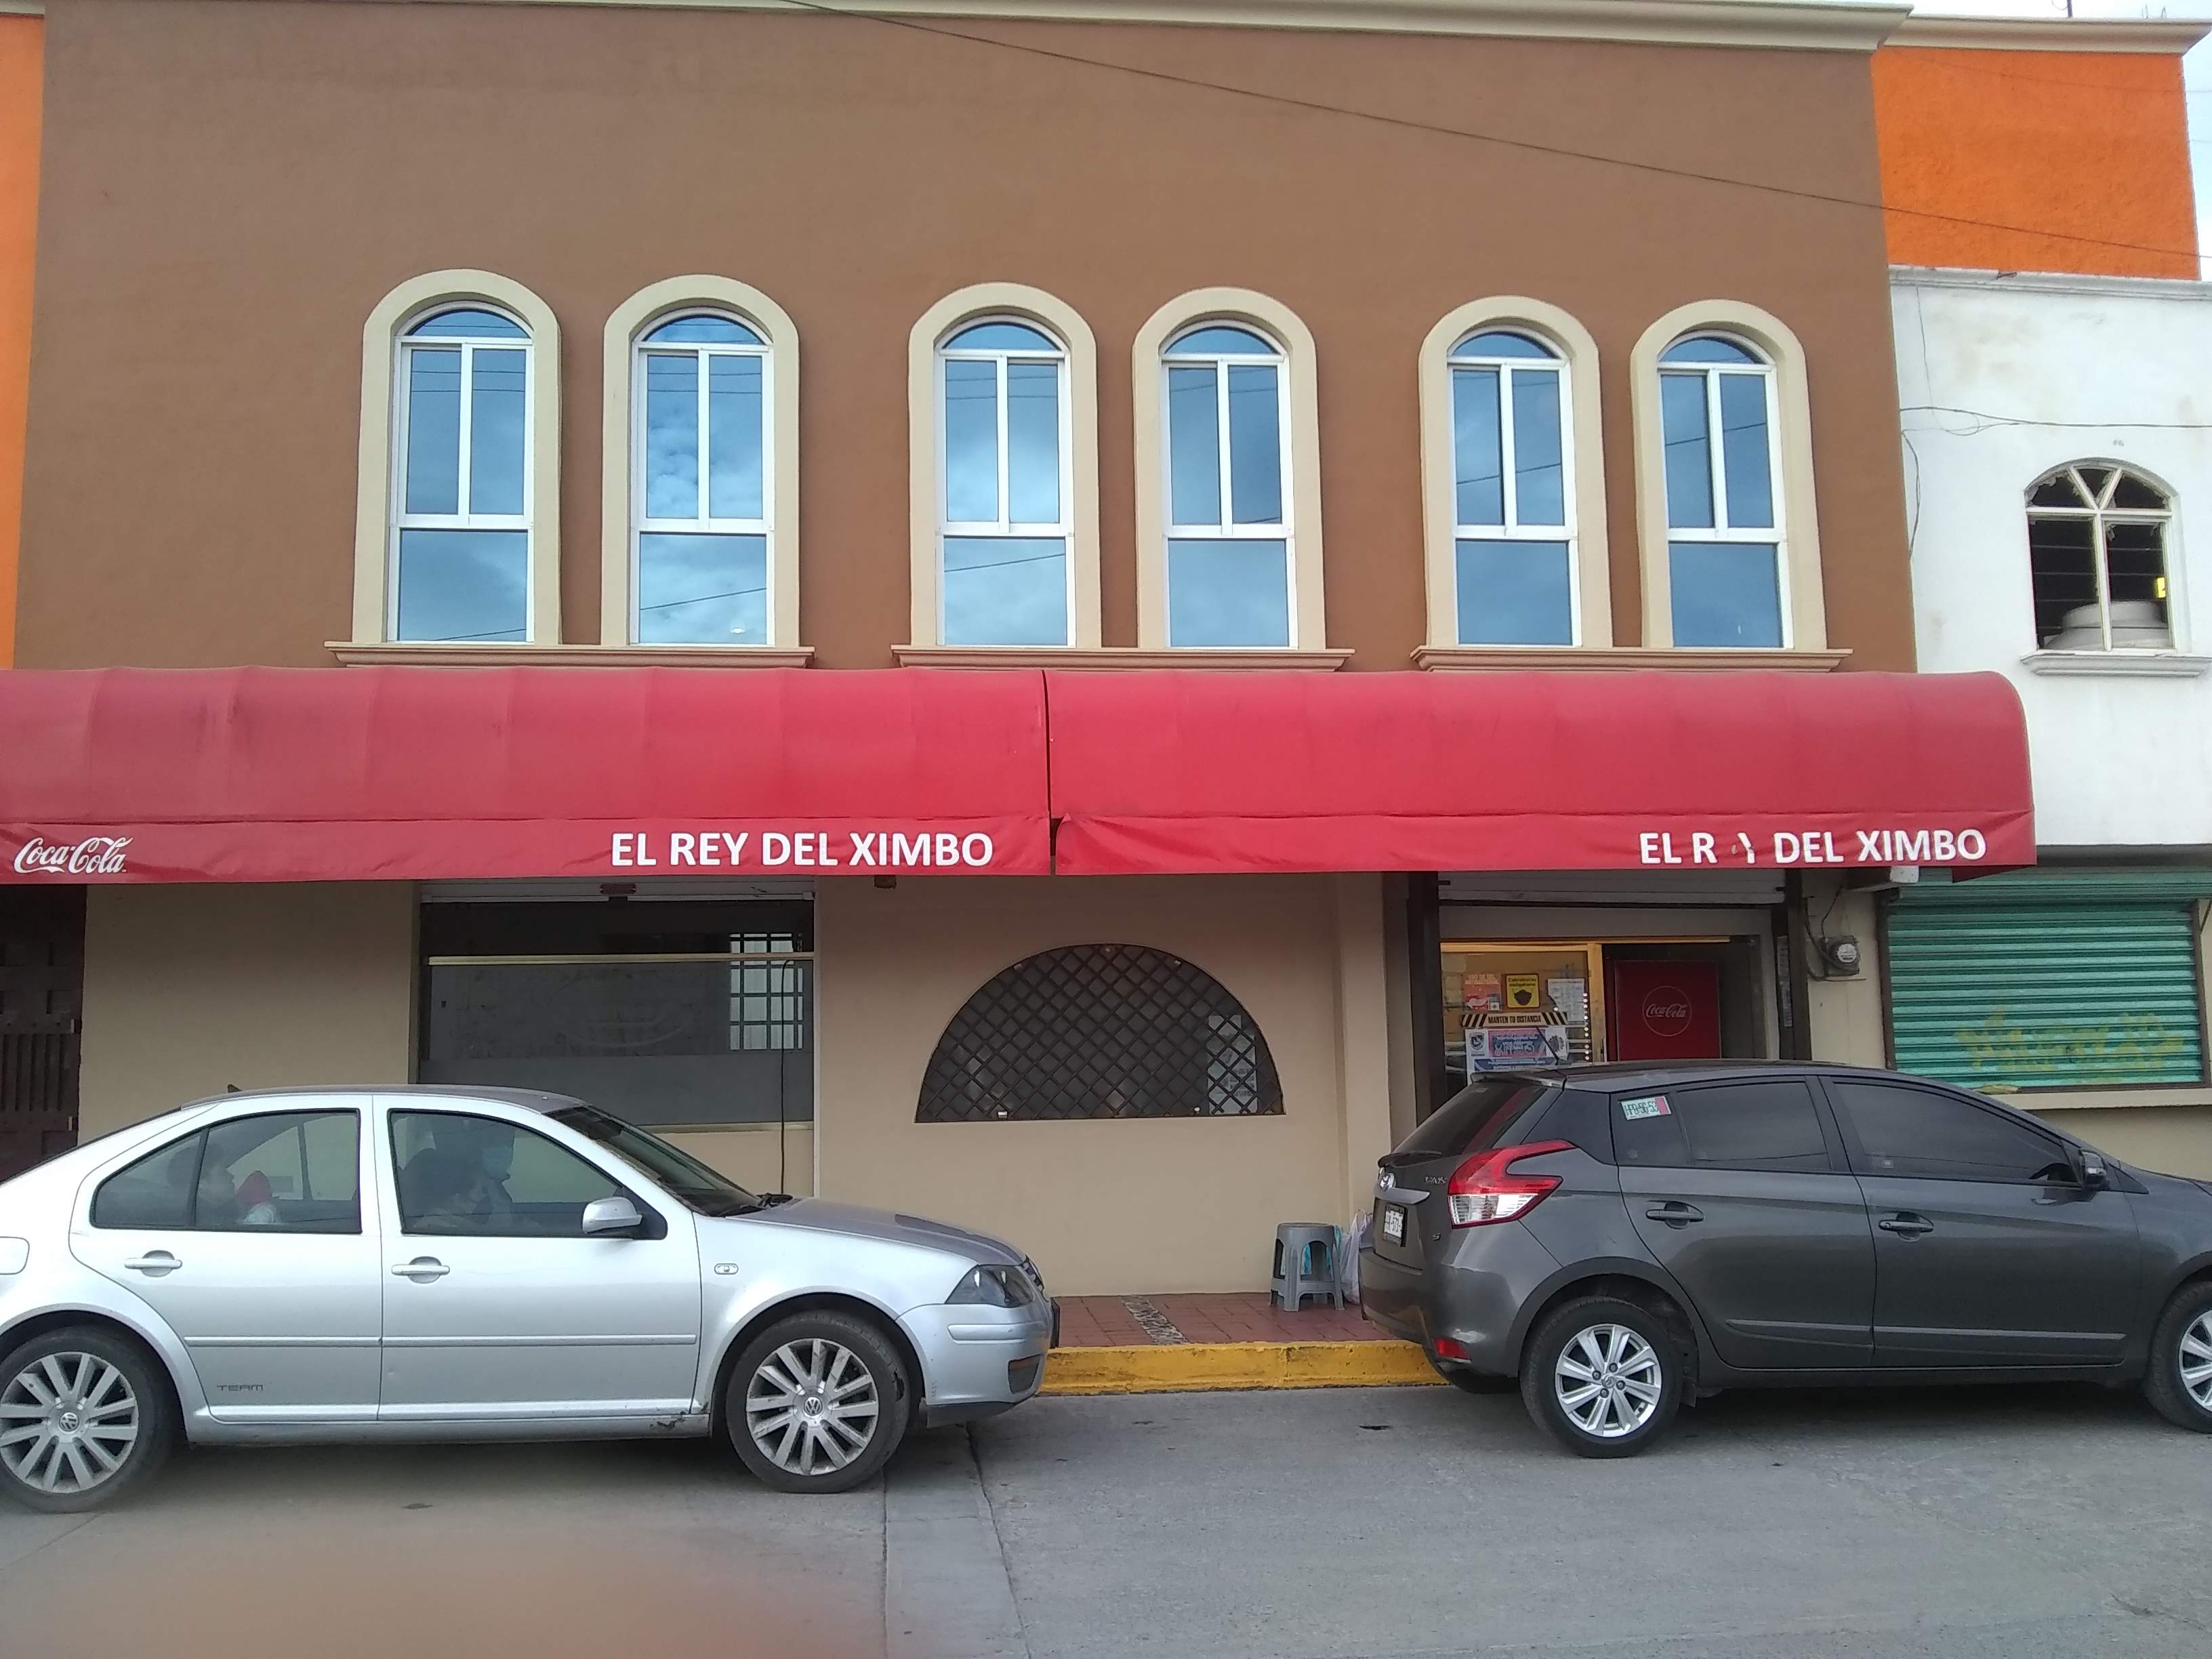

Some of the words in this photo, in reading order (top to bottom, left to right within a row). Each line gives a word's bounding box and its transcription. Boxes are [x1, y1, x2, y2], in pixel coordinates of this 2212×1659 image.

[14, 837, 134, 874] Coca-Cola
[612, 833, 657, 866] EL
[670, 832, 749, 866] REY
[763, 832, 838, 866] DEL
[848, 832, 994, 867] XIMBO
[1640, 832, 1682, 864] EL
[1774, 831, 1844, 863] DEL
[1856, 829, 1986, 862] XIMBO
